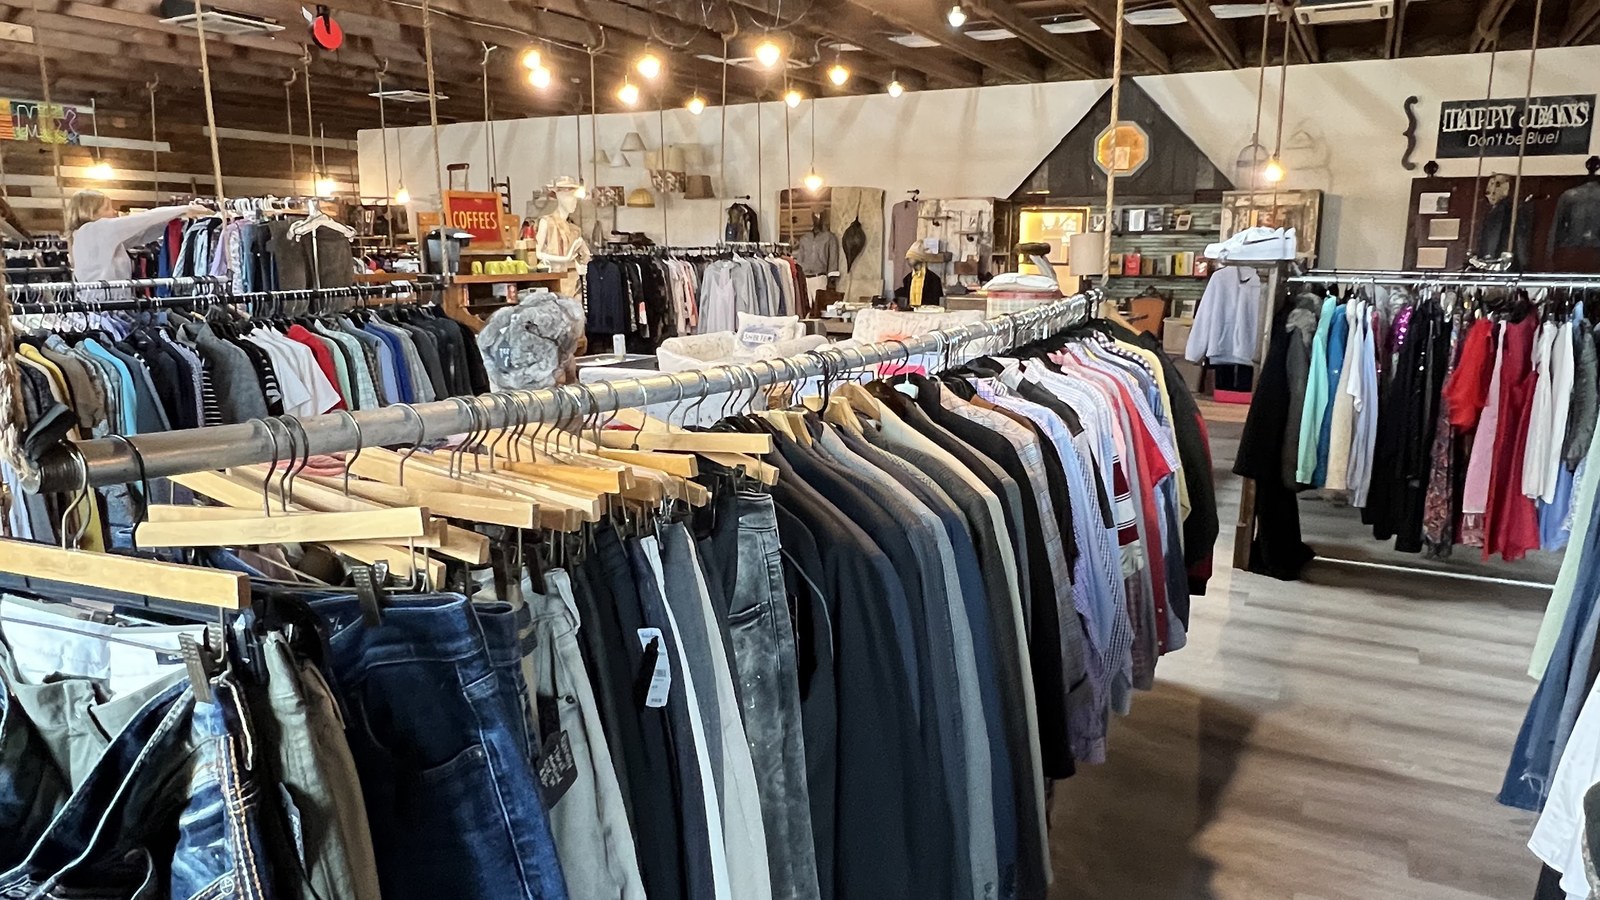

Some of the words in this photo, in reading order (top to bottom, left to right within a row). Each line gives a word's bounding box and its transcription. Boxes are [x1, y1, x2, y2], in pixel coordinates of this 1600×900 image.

[1443, 105, 1516, 132] HAPPY
[1519, 102, 1590, 128] JEANS
[1467, 132, 1502, 147] Don't
[1505, 132, 1522, 145] be
[1526, 130, 1560, 145] Blue!
[453, 210, 498, 230] COFFEES
